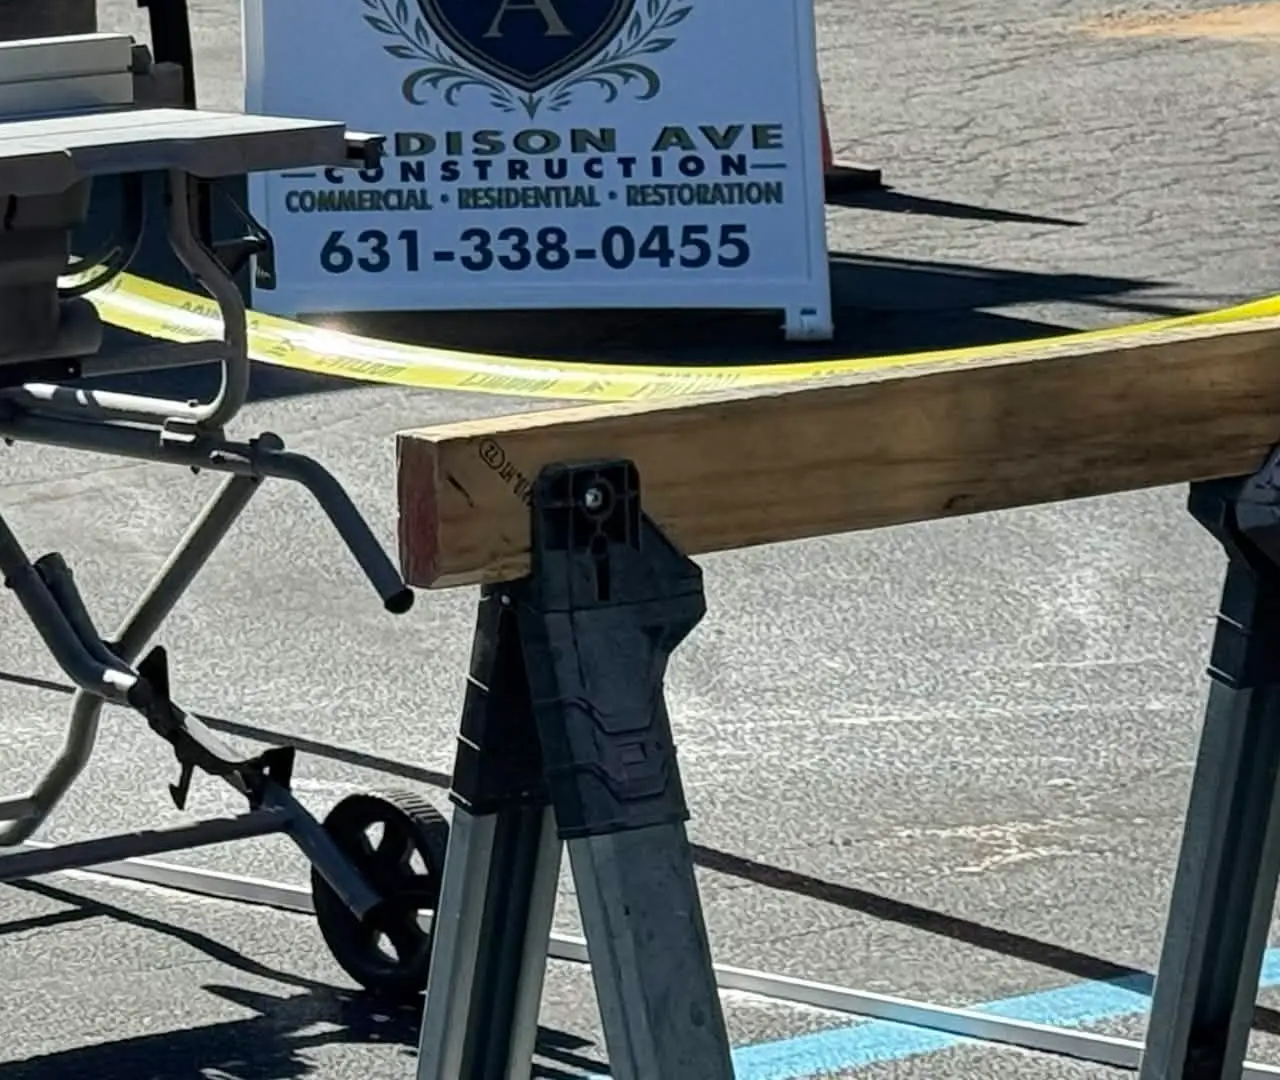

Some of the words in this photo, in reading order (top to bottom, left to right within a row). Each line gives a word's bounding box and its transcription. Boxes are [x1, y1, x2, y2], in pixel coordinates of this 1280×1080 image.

[382, 127, 617, 158] DISON
[652, 123, 784, 151] AVE
[325, 154, 747, 184] CONSTRUCTION
[285, 189, 432, 213] COMMERCIAL
[458, 185, 600, 210] RESIDENTIAL
[626, 181, 784, 207] RESTORATION
[320, 223, 751, 274] 631-338-0455
